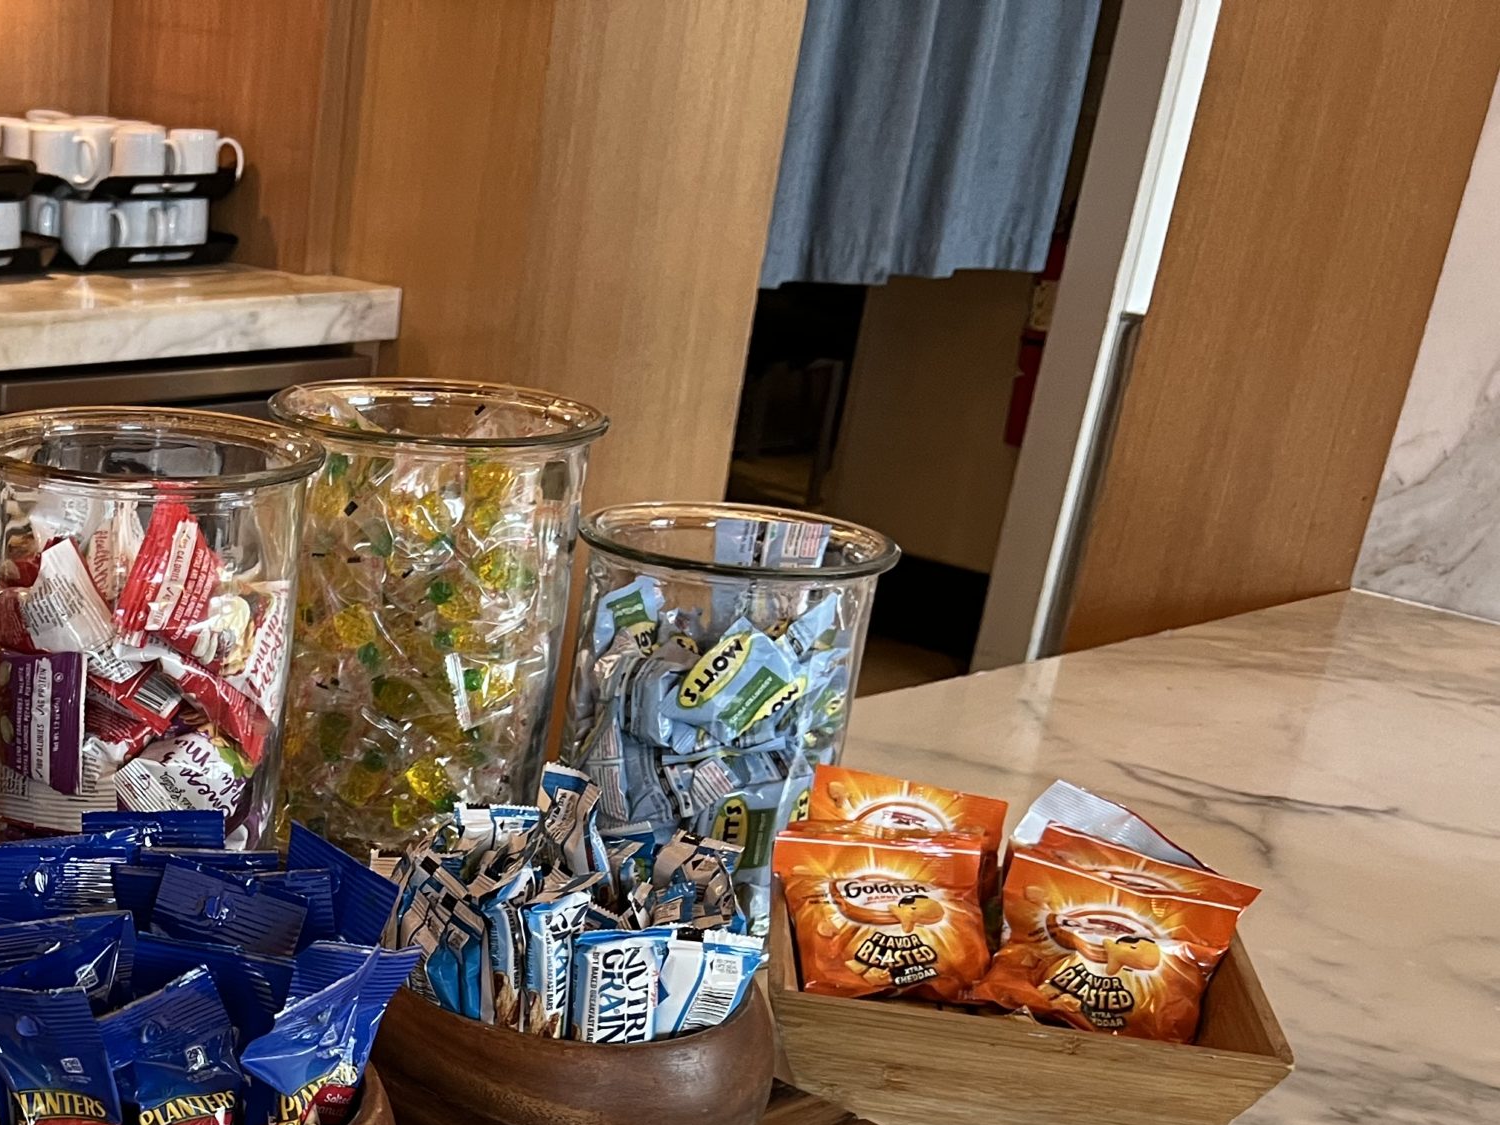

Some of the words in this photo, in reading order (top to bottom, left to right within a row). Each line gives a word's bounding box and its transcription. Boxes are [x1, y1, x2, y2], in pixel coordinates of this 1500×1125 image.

[37, 667, 46, 698] PROTEIN
[36, 723, 44, 756] CALORIES
[857, 941, 936, 967] BLASTED
[871, 932, 923, 948] FLAVOR
[591, 966, 600, 988] BAKED
[895, 968, 937, 985] CHEDDAR
[1056, 968, 1133, 1010] BLASTED
[1076, 964, 1123, 989] FLAVOR
[589, 987, 598, 1024] BREAKFAST
[596, 948, 626, 1044] GRAIN
[624, 945, 649, 1044] NUTRI
